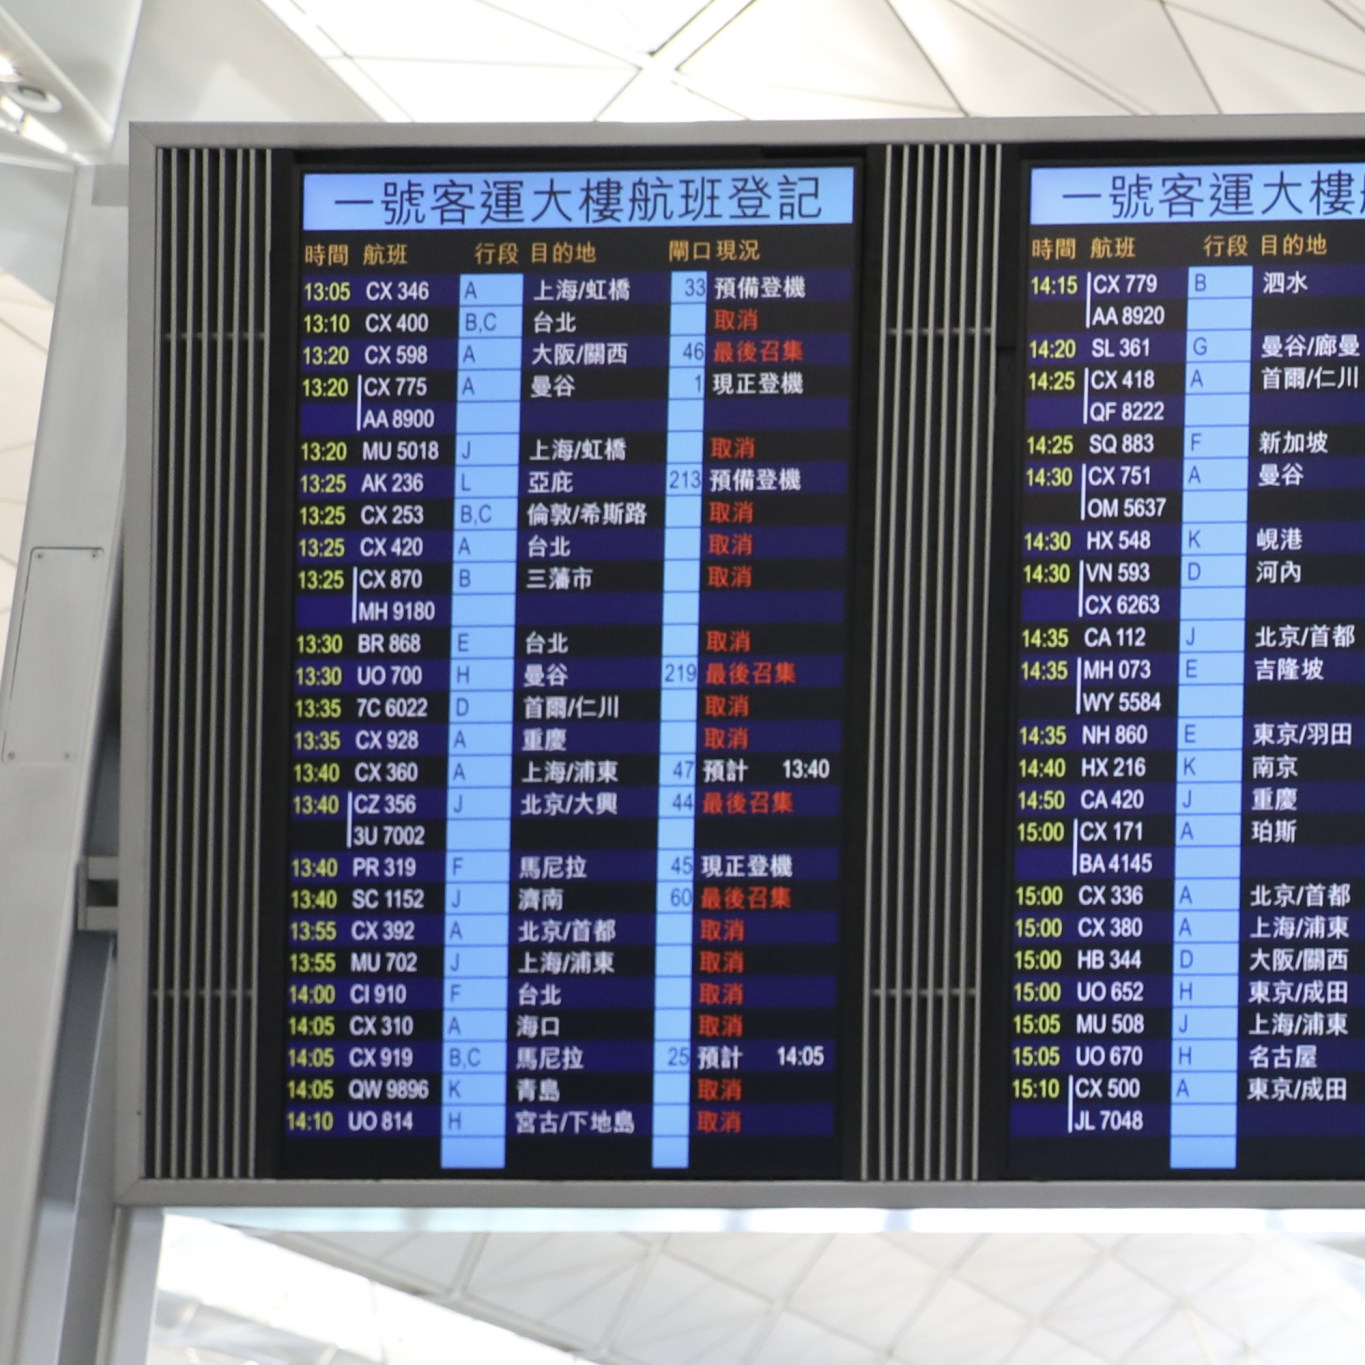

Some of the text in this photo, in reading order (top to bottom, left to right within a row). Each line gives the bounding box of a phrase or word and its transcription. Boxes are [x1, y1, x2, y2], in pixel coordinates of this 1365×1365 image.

[334, 176, 823, 227] 一號客運大樓航班登記
[304, 243, 349, 267] 時間
[362, 243, 408, 266] 航班
[474, 242, 519, 265] 行段
[531, 241, 597, 264] 目的地
[716, 239, 761, 261] 現況
[1031, 237, 1077, 261] 時間
[1090, 236, 1136, 259] 航班
[1203, 234, 1248, 258] 行段
[1261, 233, 1328, 256] 目的地
[304, 275, 806, 302] 13:05 CX 346 A 上海/虹橋 33 預備登機
[1031, 275, 1078, 295] 14:15
[1093, 274, 1121, 295] CX
[1125, 273, 1158, 294] 779
[1194, 273, 1207, 292] B
[1091, 305, 1165, 326] AA 8920
[1024, 530, 1072, 551] 14:30
[1086, 530, 1114, 550] HX
[1118, 529, 1151, 550] 548
[1188, 529, 1201, 548] K
[294, 758, 830, 784] 13:40 CX 360 A 上海/浦東 47 預計 13:40
[1013, 1013, 1061, 1035] 15:05
[1076, 1013, 1107, 1034] MU
[1111, 1013, 1145, 1034] 508
[1178, 1014, 1188, 1034] J
[1248, 1011, 1348, 1037] 上海/浦東
[287, 1110, 334, 1131] 14:10
[348, 1110, 378, 1132] UO
[381, 1110, 414, 1131] 814
[448, 1112, 462, 1130] H
[697, 1110, 741, 1133] 取消
